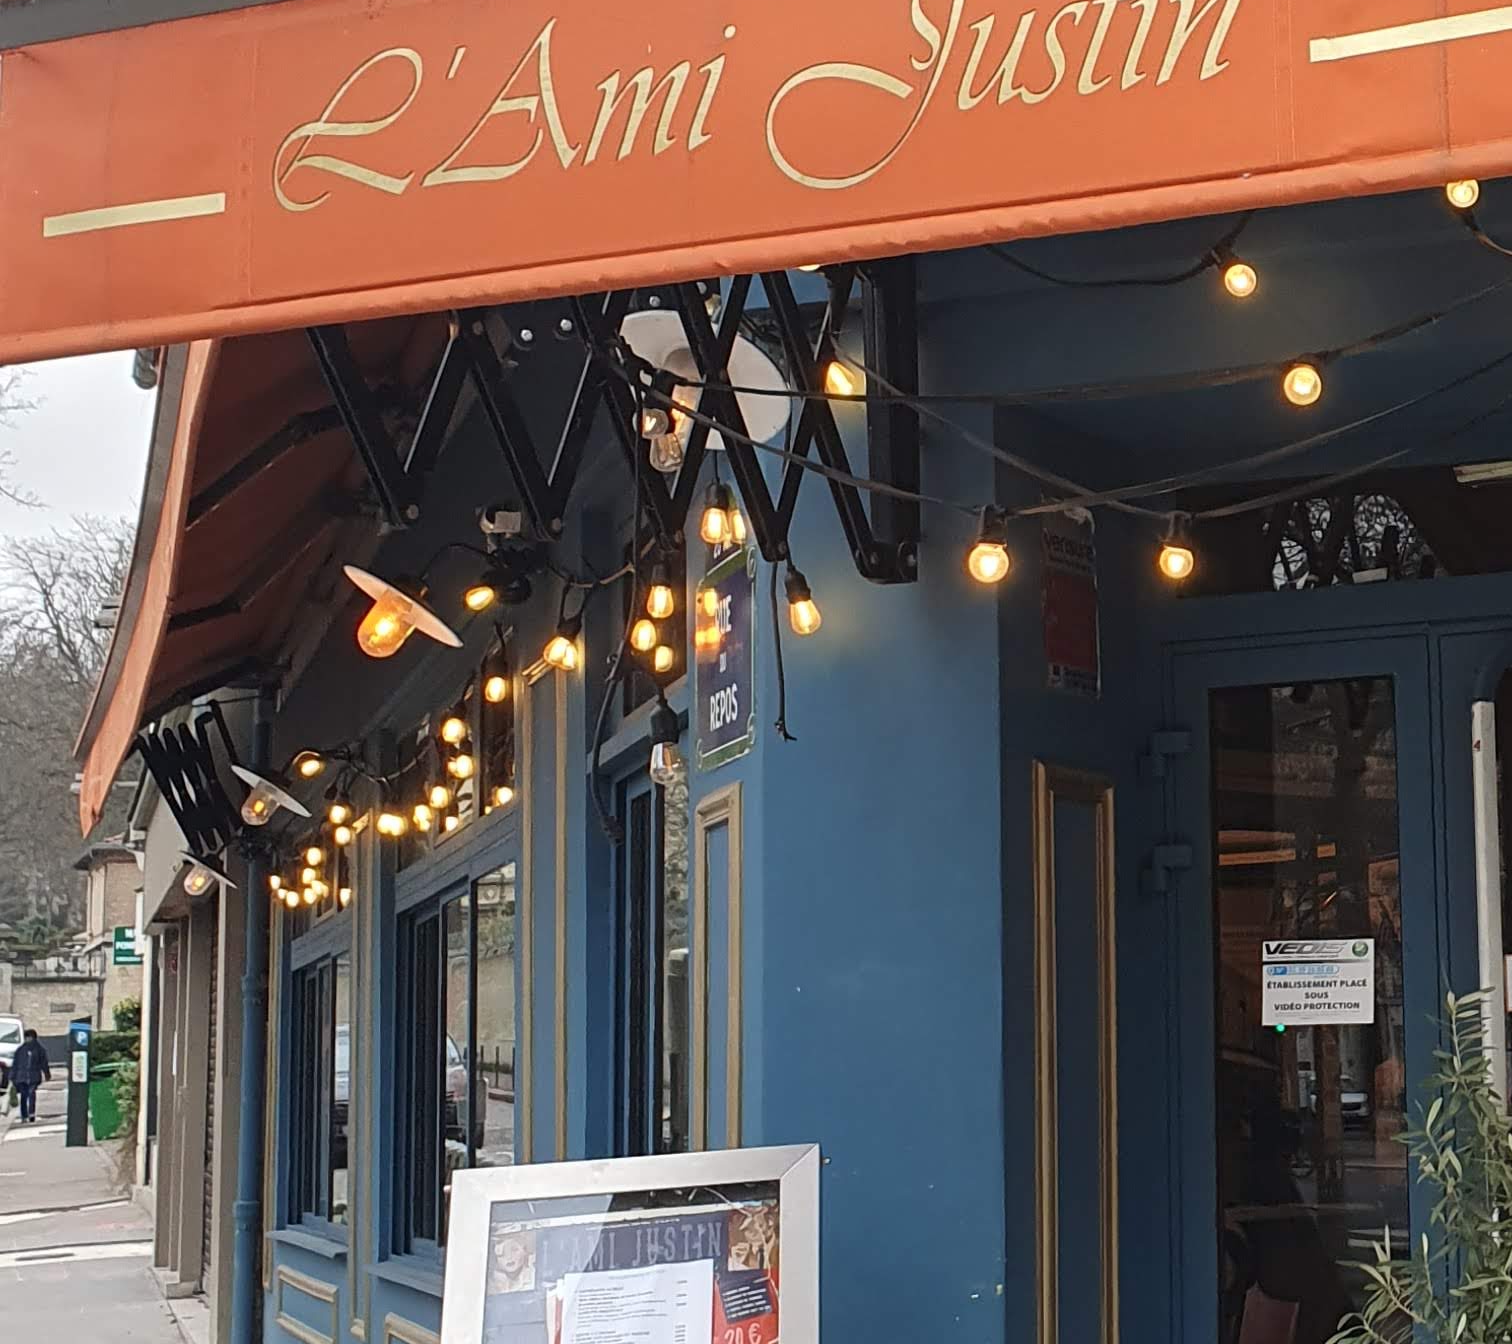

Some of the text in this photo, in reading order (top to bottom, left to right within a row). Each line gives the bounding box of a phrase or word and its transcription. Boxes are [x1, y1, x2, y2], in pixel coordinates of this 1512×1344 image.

[272, 16, 738, 211] L'Ami
[710, 682, 738, 733] REPOS
[1267, 978, 1367, 989] ÉTABLISSEMENT PLACÉ
[1274, 1002, 1360, 1011] VIDÉO PROTECTION
